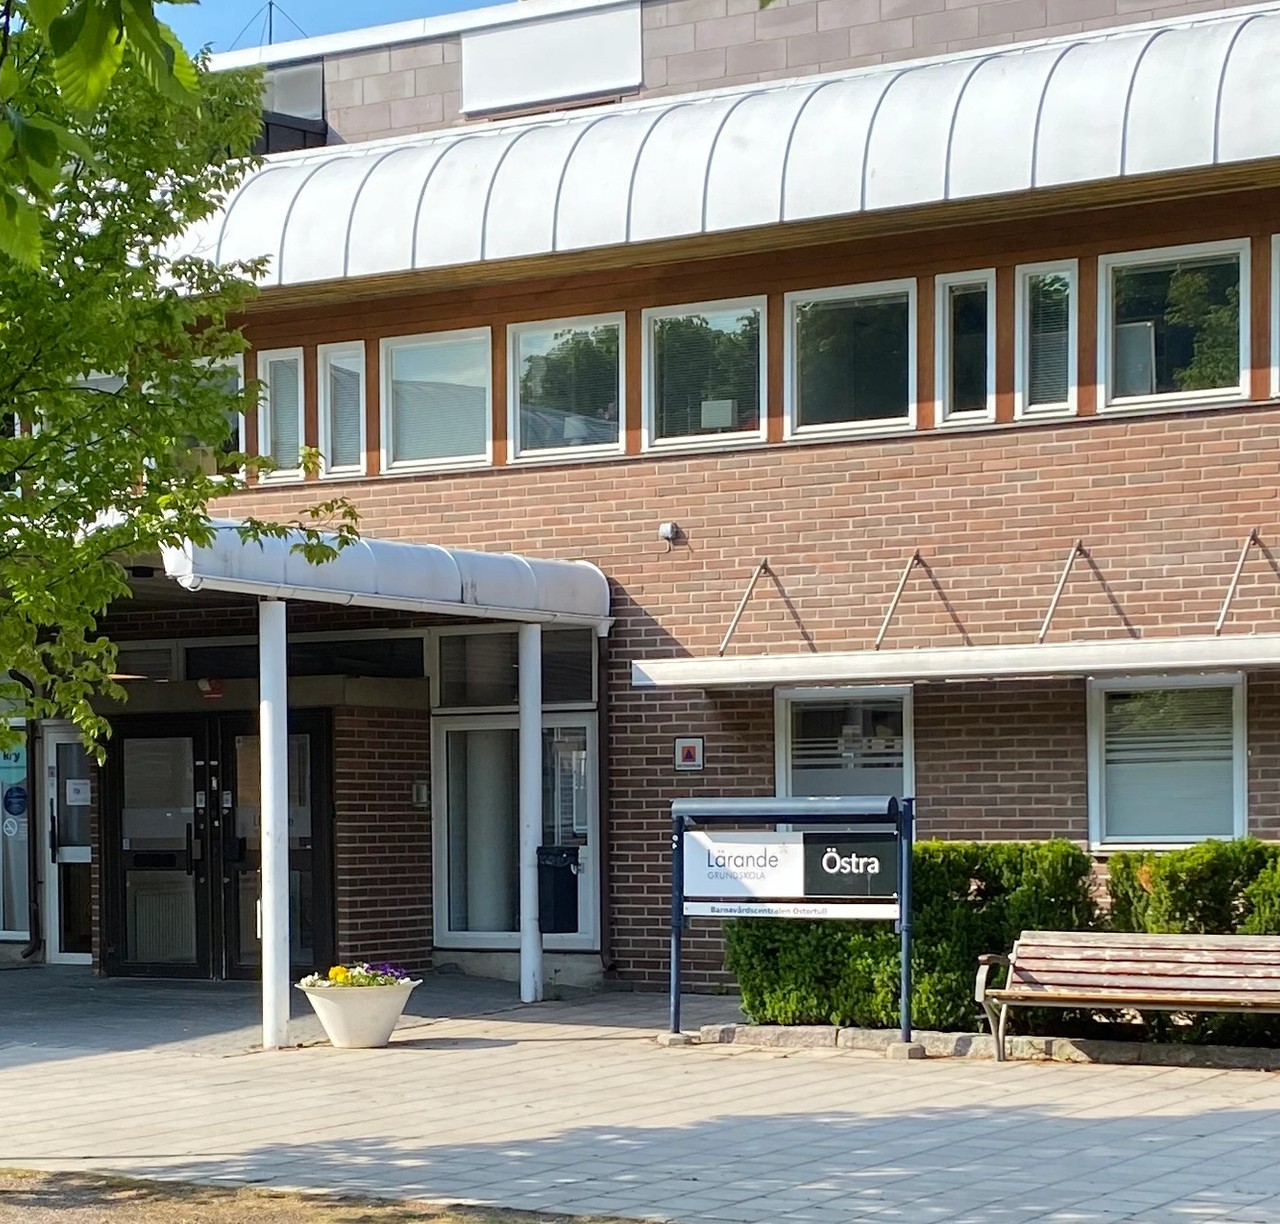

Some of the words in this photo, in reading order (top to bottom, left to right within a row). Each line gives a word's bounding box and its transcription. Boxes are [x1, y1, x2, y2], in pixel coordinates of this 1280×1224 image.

[707, 847, 779, 868] Lärande
[821, 847, 880, 874] Östra
[707, 871, 766, 880] GRUNDSKOLA
[710, 905, 791, 915] Barnavårdscentralen
